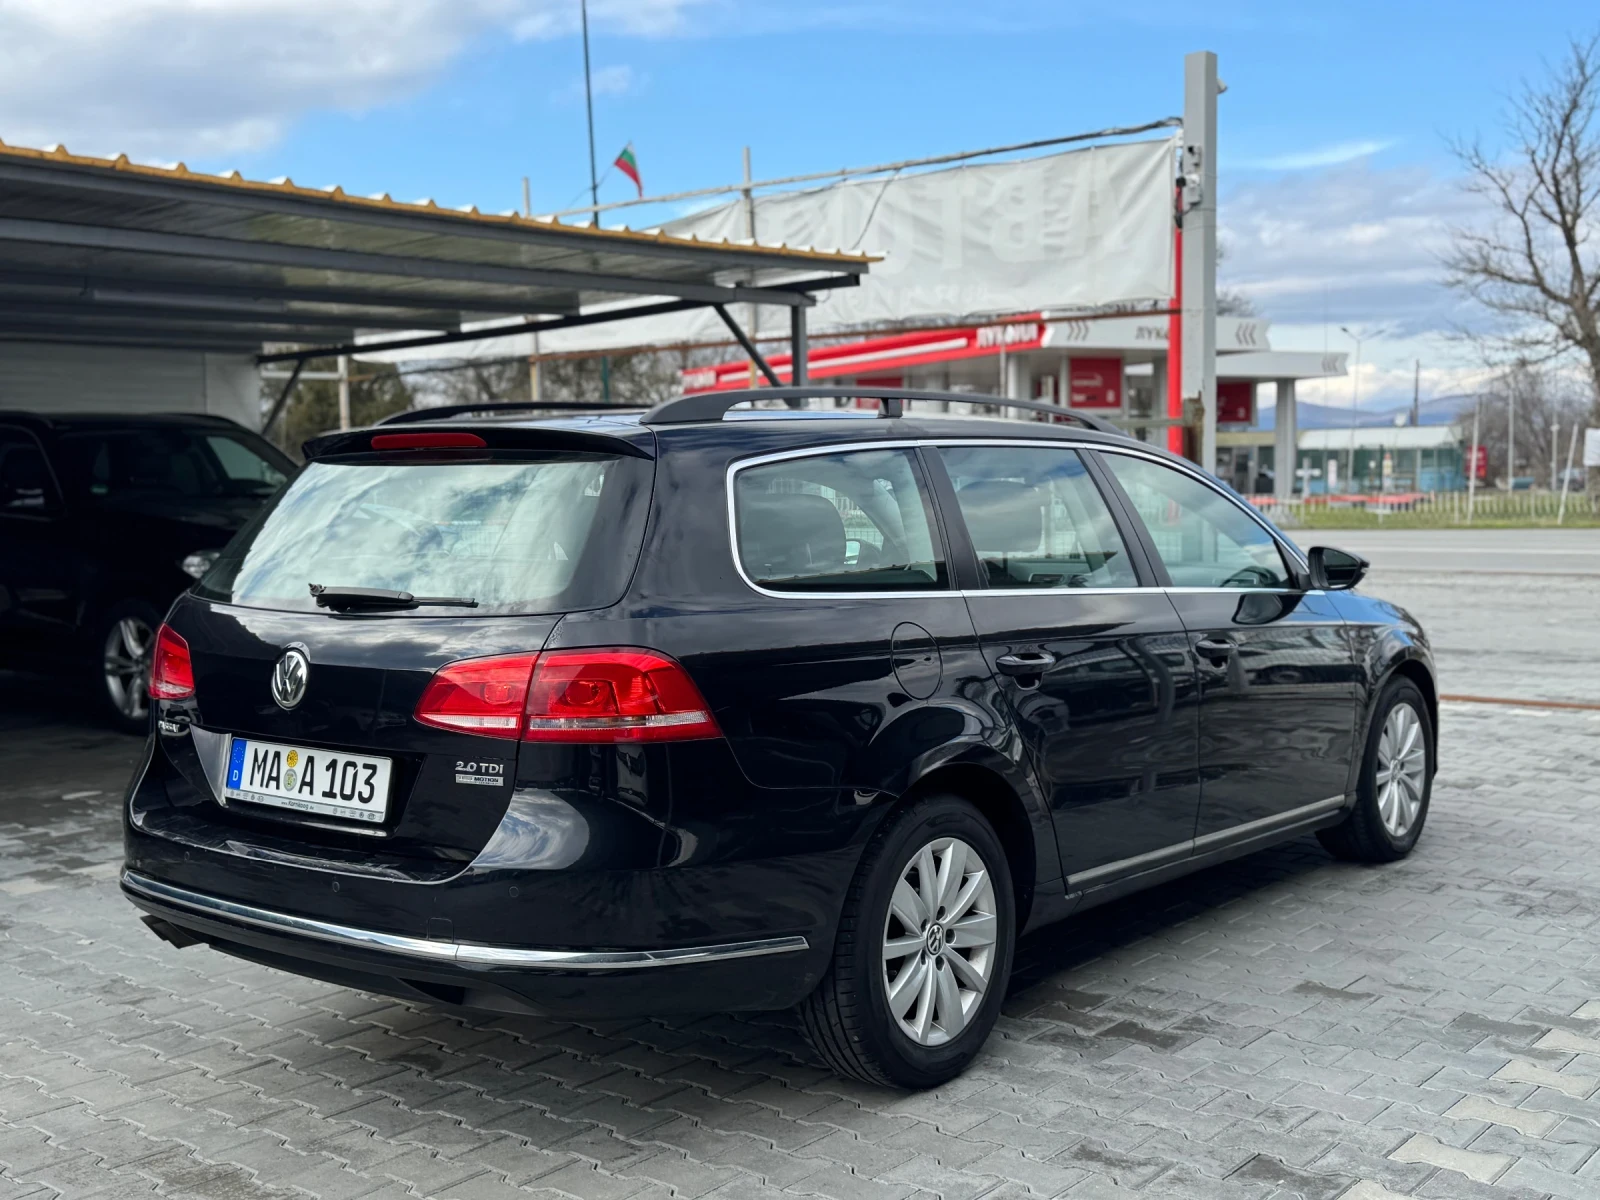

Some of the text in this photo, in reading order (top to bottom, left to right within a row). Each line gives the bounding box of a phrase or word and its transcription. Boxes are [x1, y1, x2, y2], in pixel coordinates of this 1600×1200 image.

[454, 760, 504, 774] 2.0 TDI
[232, 769, 240, 781] D
[249, 747, 378, 804] MA A 103
